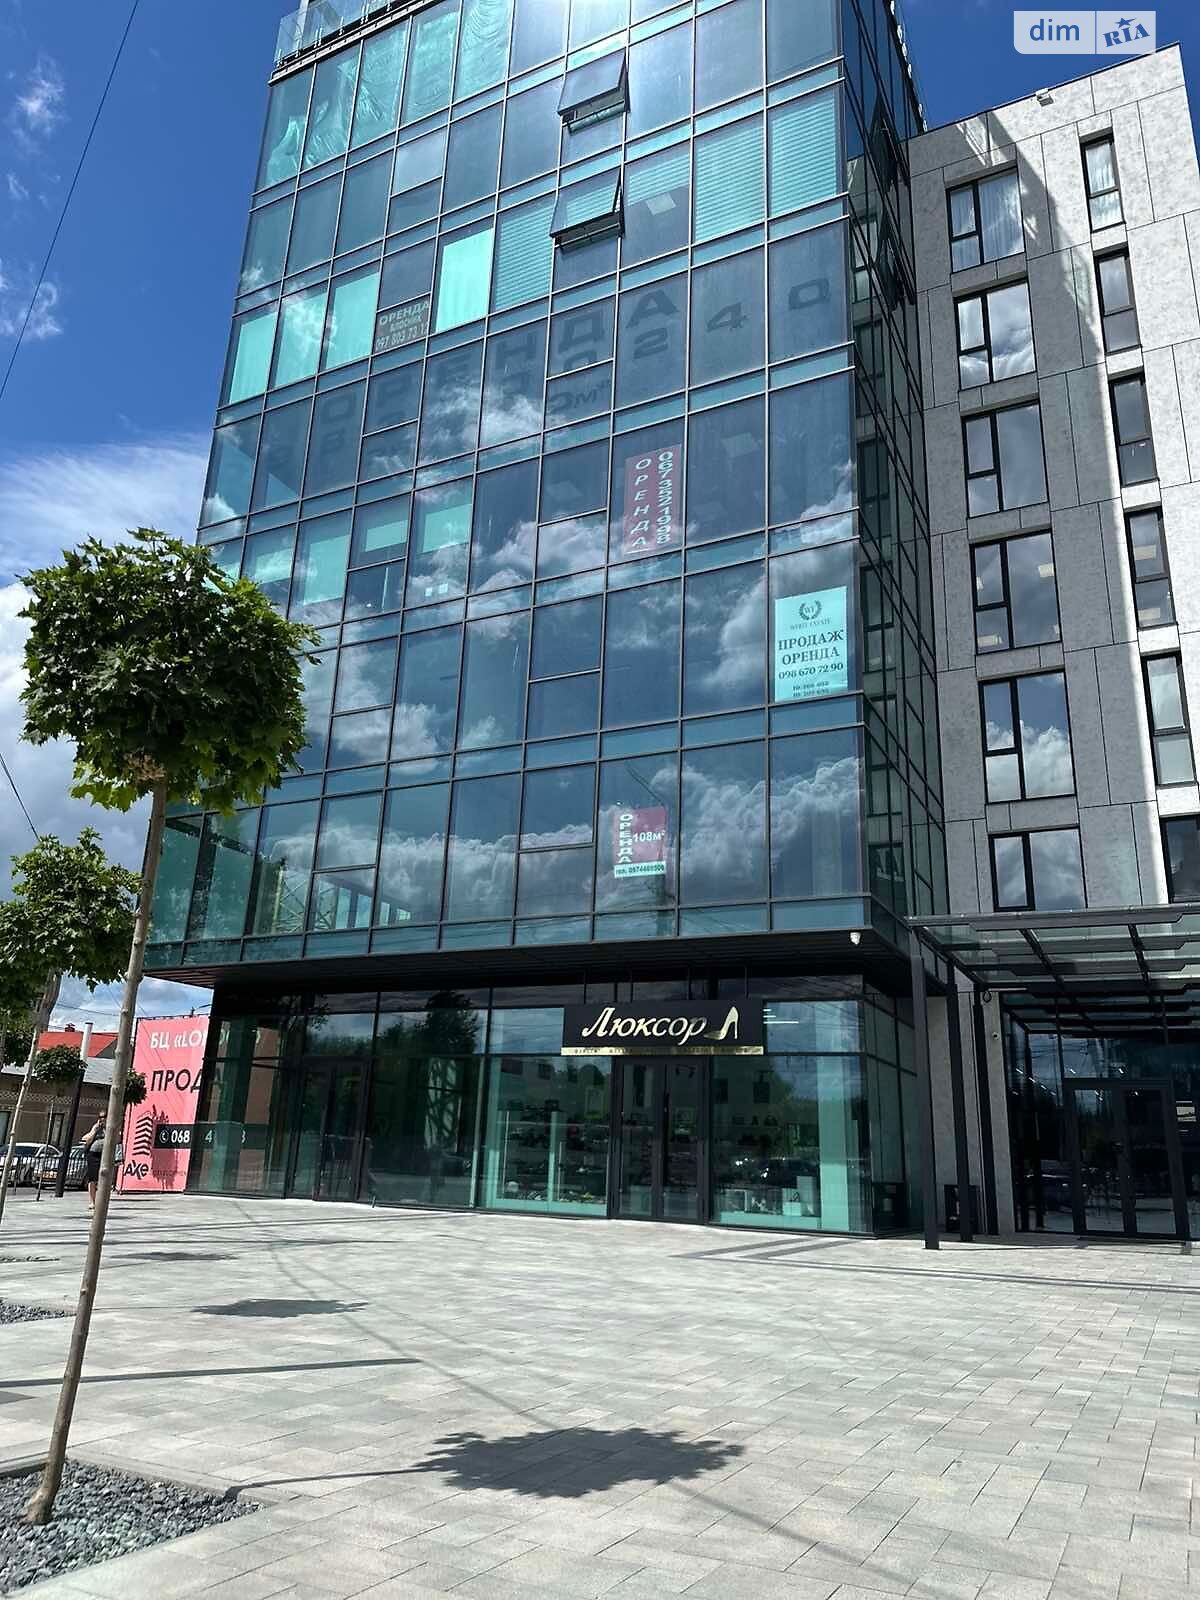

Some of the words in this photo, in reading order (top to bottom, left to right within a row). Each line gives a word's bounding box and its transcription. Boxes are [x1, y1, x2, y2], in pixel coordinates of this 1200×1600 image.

[379, 300, 430, 326] ОРЕНДА
[629, 458, 652, 547] ОРЕНДА
[778, 629, 844, 651] ПРОДАЖ
[782, 646, 840, 666] ОРЕНДА
[617, 813, 633, 863] ОРЕНДА
[581, 1006, 708, 1046] Люксор
[151, 1031, 170, 1050] БЦ
[170, 1130, 191, 1143] 068
